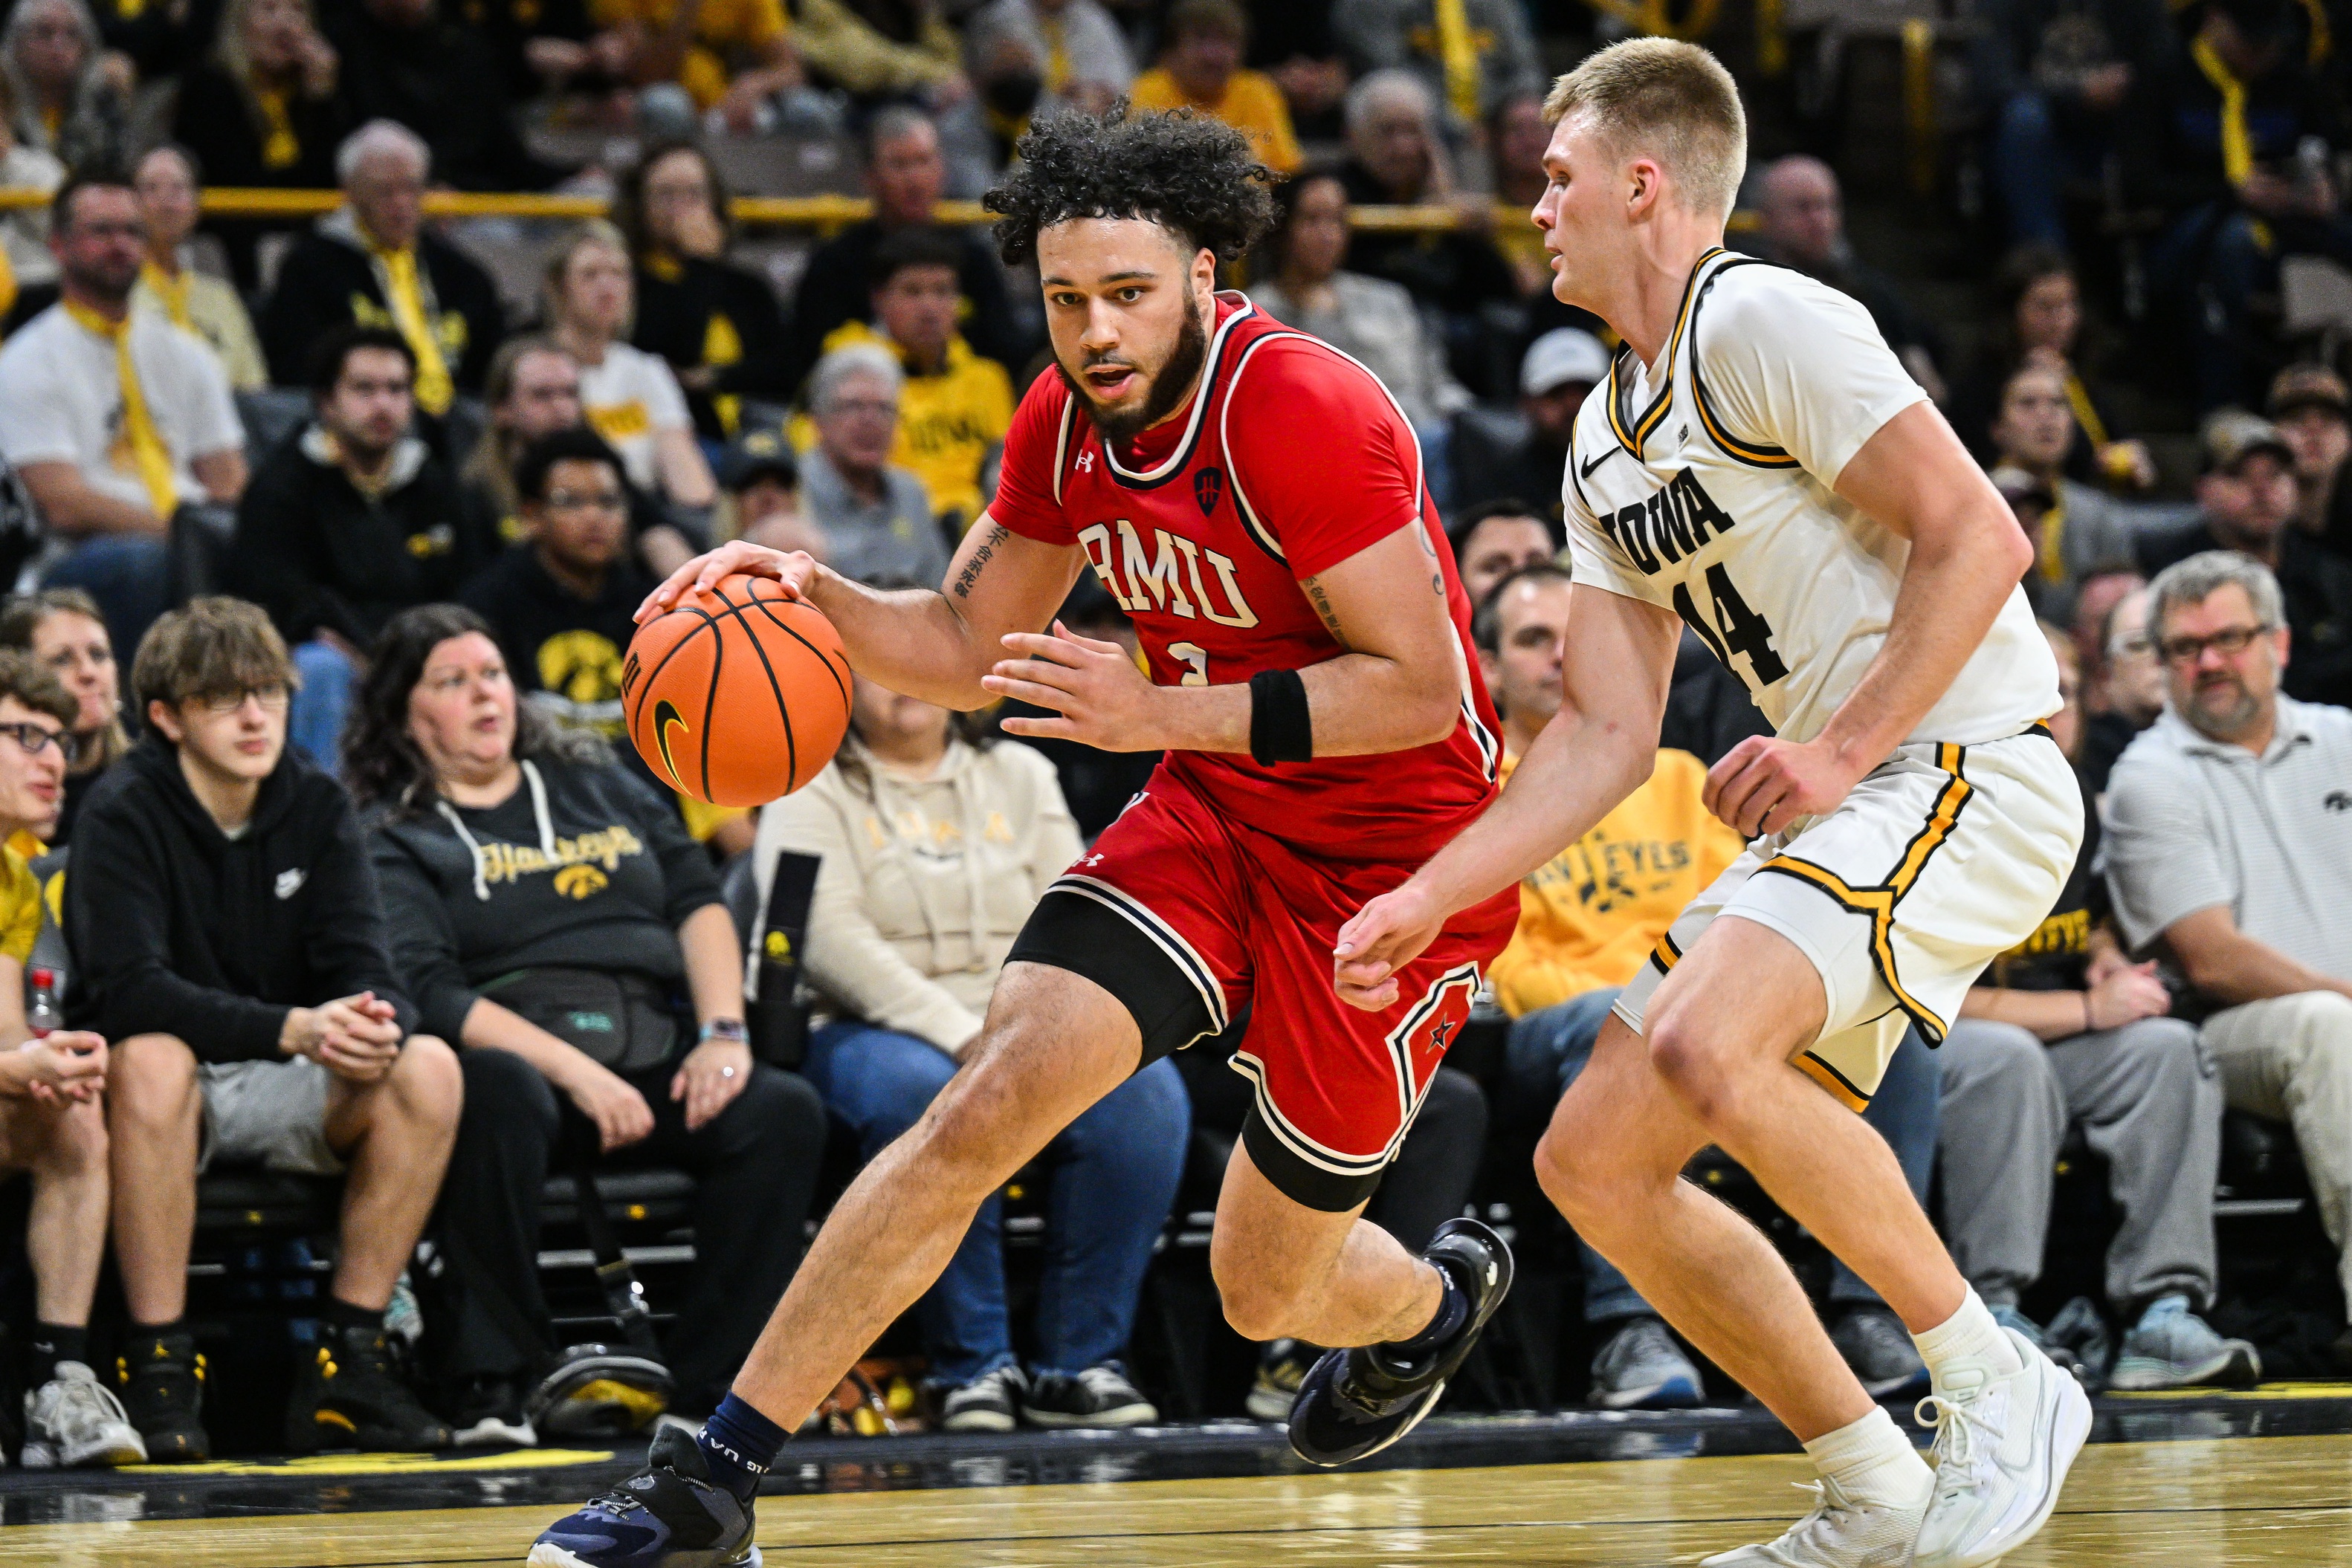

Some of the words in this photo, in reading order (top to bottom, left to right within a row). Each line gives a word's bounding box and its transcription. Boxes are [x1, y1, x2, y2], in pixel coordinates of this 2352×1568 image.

[1076, 519, 1261, 629] RMU
[1598, 466, 1736, 577] IOWA
[1673, 561, 1791, 694] 14
